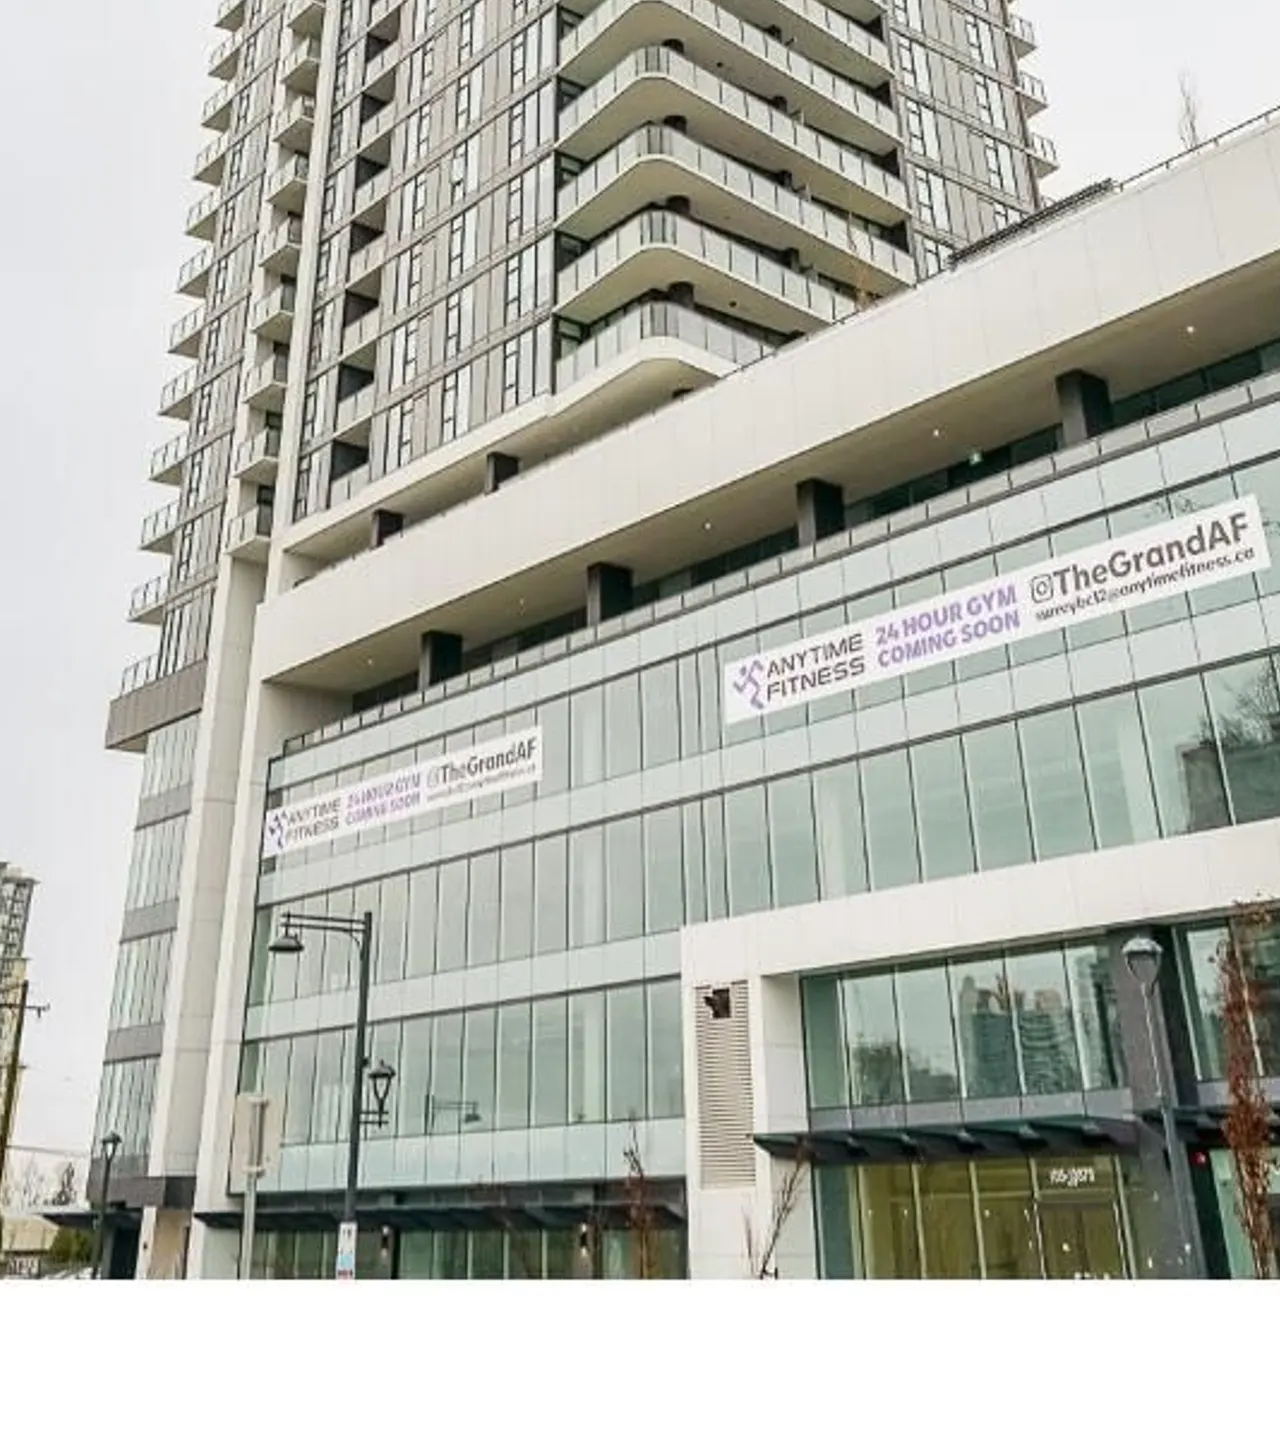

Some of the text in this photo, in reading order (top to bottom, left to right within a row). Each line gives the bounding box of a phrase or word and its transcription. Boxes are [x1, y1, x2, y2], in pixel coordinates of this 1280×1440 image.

[1053, 512, 1248, 596] TheGrandAF
[875, 584, 1017, 646] 24 HOUR GYM
[877, 611, 1020, 668] COMING SOON
[767, 633, 863, 678] ANYTIME
[767, 656, 865, 702] FITNESS
[440, 736, 537, 784] TheGrandAF
